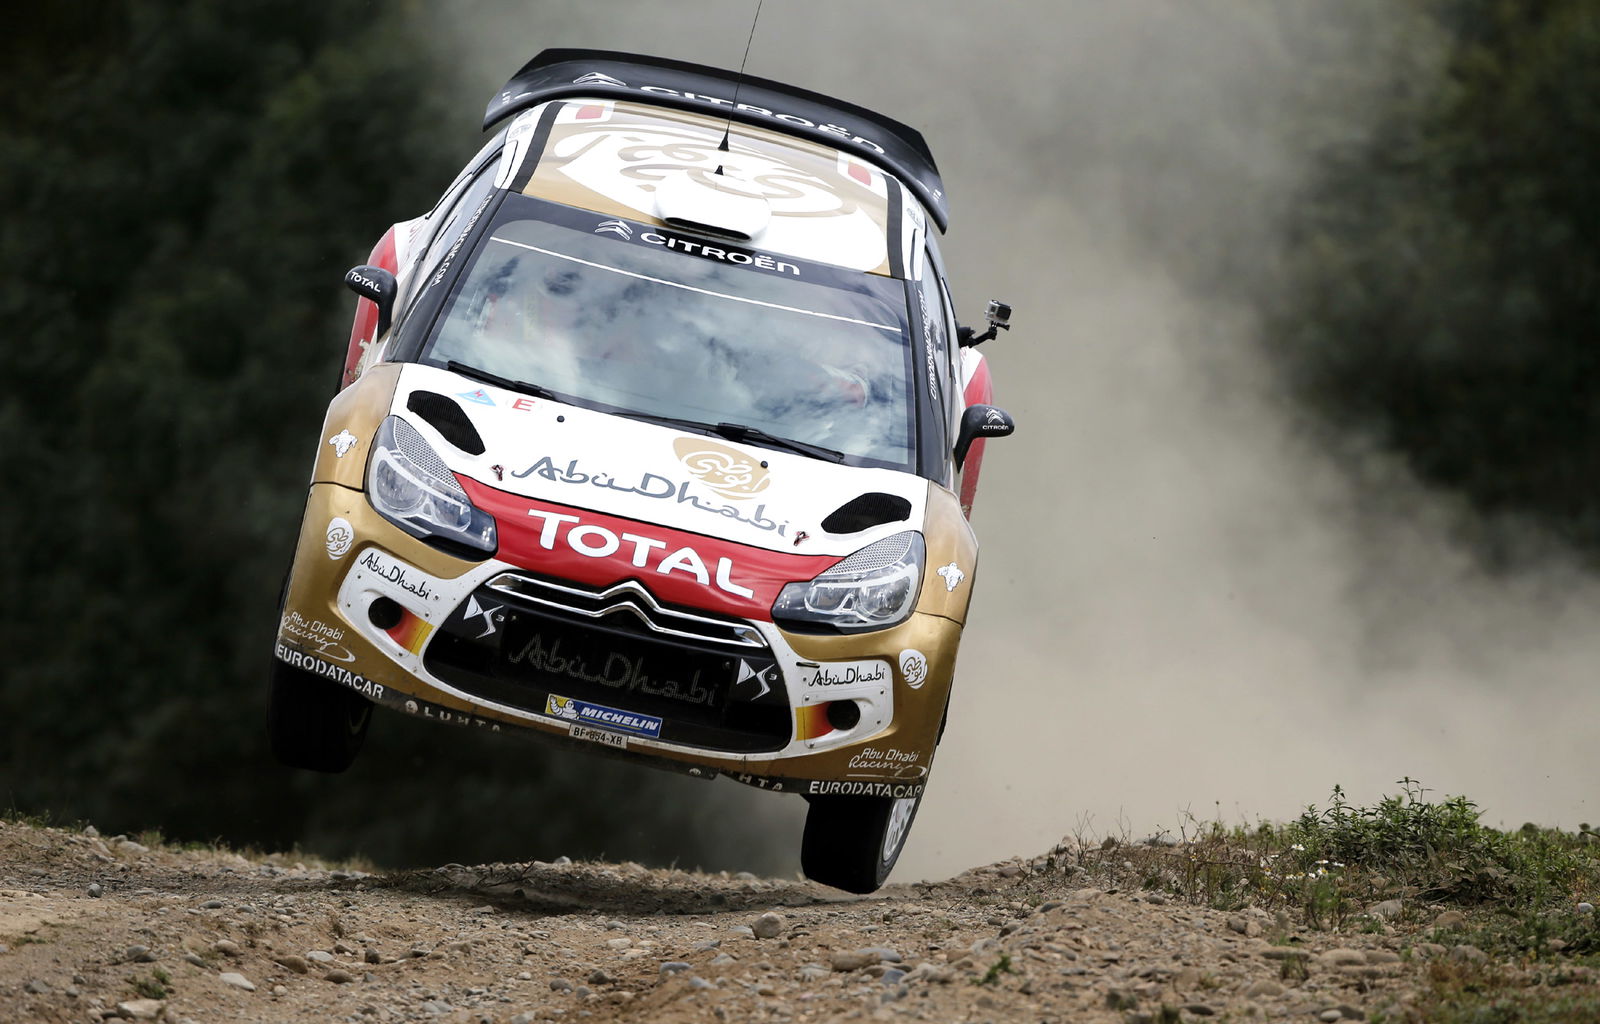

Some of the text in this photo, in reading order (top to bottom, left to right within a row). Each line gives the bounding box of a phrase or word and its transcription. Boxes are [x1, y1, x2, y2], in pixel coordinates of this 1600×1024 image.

[349, 270, 382, 294] TOTAL
[511, 397, 536, 412] E
[527, 507, 754, 600] TOTAL
[283, 615, 338, 651] Racing
[291, 611, 345, 641] Abu Dhabi
[276, 643, 385, 699] EURODATACAR
[580, 706, 659, 731] MICHELIN
[848, 754, 914, 777] Racing
[861, 747, 920, 762] Abu Dhabi
